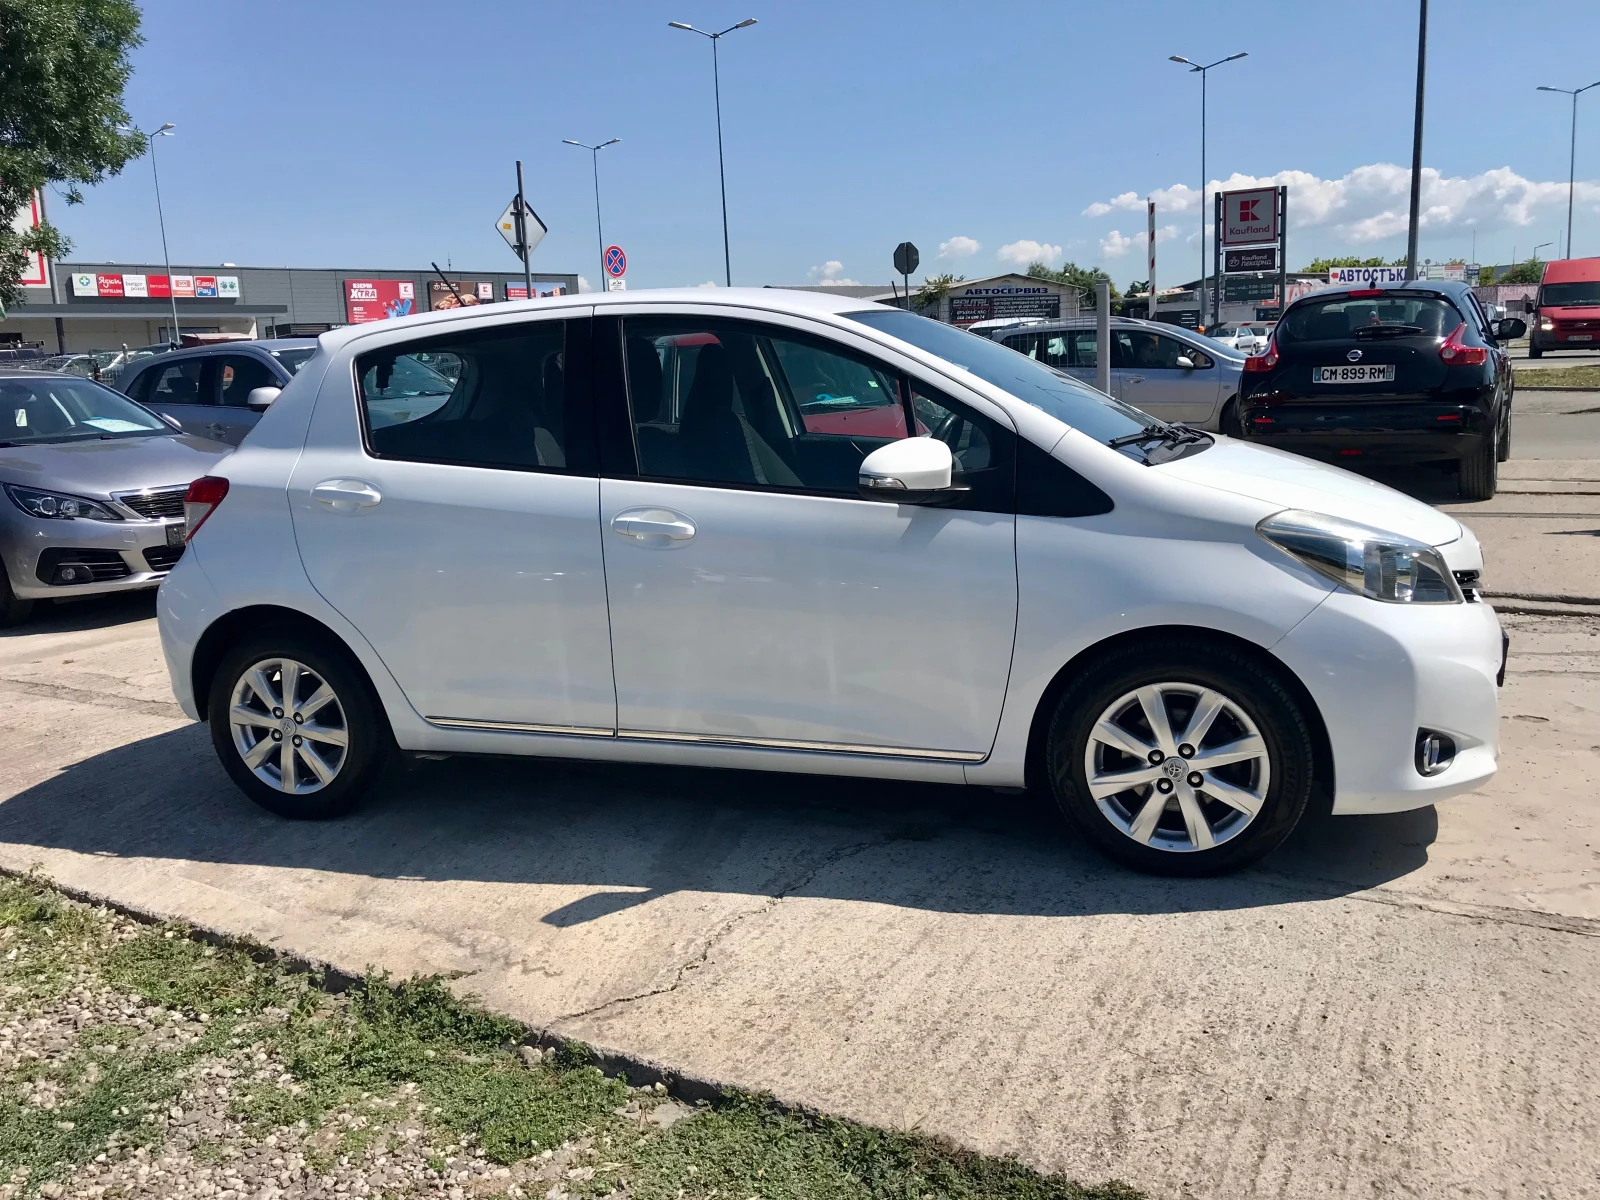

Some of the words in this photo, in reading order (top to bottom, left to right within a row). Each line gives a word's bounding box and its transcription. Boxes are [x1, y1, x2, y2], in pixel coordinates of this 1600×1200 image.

[1230, 225, 1270, 235] Kaufland
[1339, 268, 1419, 282] АВТОСТЪК
[197, 280, 215, 288] Easy
[198, 287, 212, 295] Pay
[965, 287, 1048, 295] АВТОСЕРВИЗ
[1322, 367, 1386, 381] CM-899-RM
